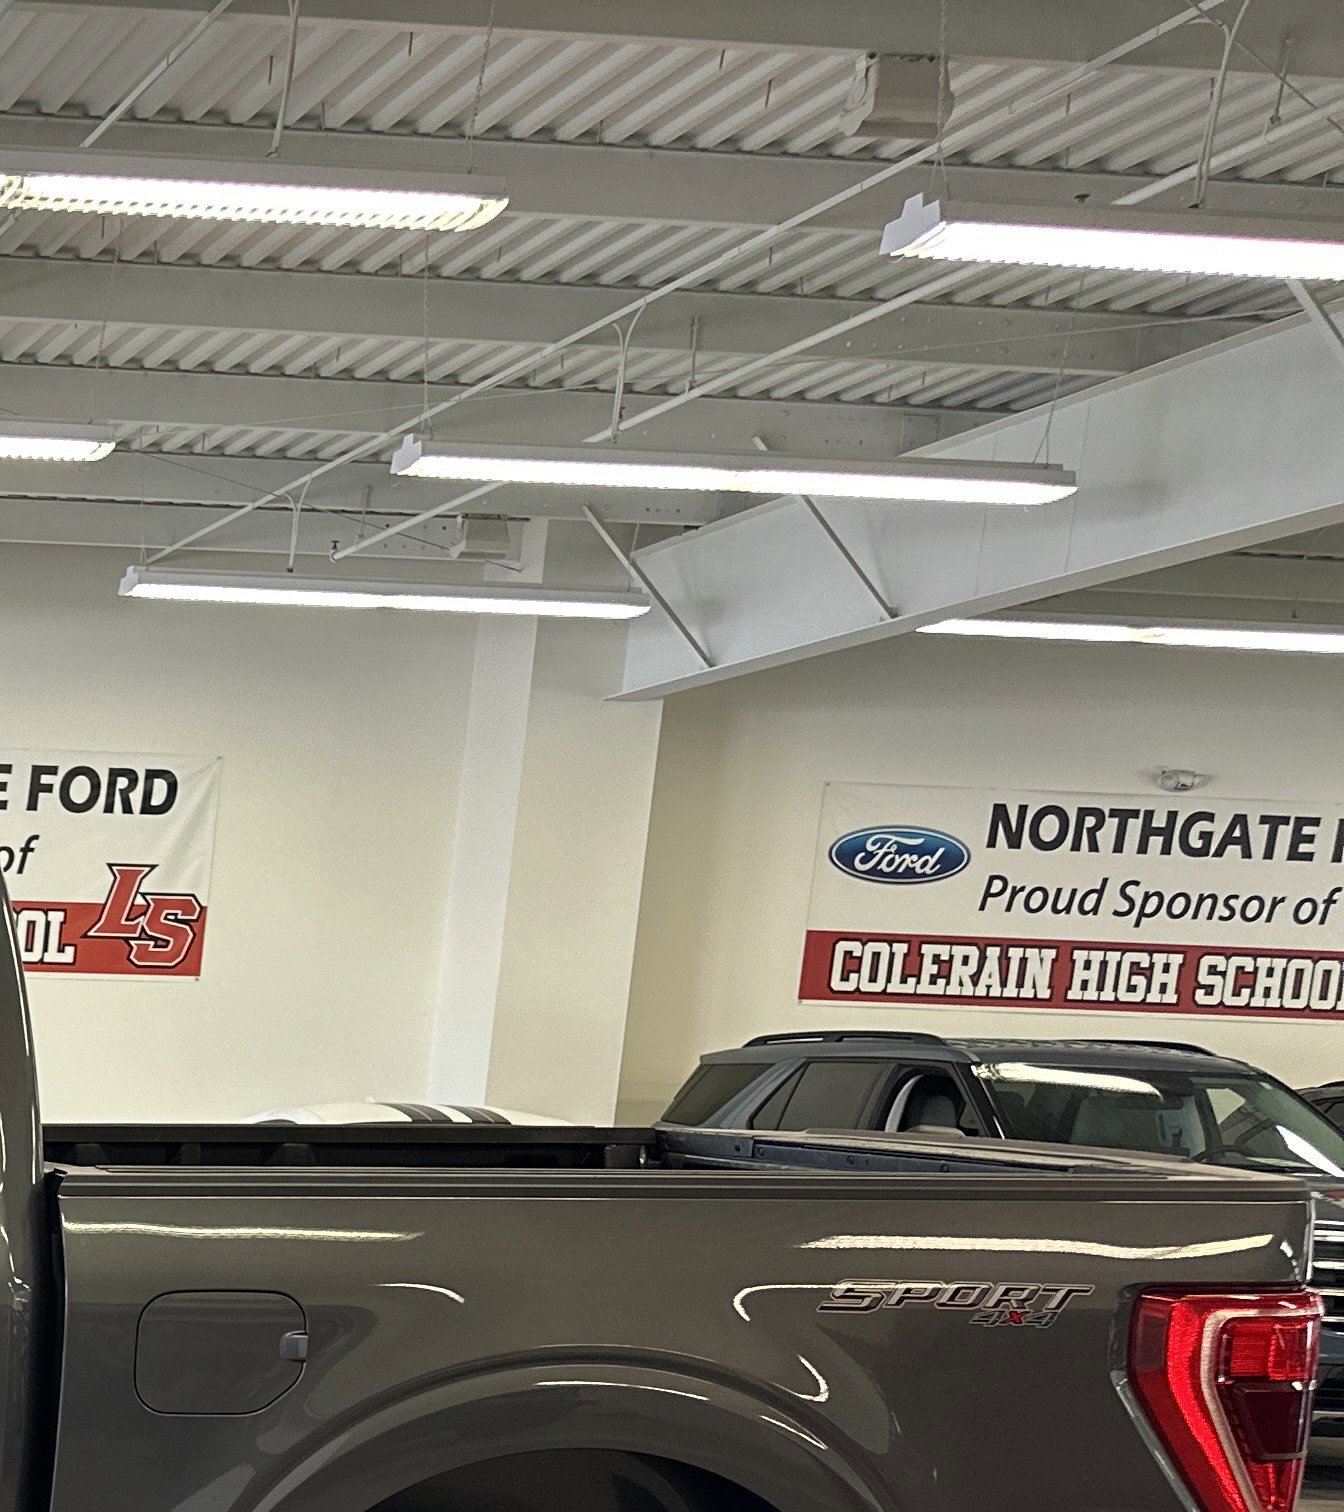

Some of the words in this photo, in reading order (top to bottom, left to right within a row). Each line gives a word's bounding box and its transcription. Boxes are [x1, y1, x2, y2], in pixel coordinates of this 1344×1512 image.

[25, 764, 178, 815] FORD
[853, 832, 942, 877] Ford
[985, 802, 1322, 863] NORTHGATE
[79, 862, 204, 969] LS
[977, 874, 1108, 917] Proud
[1112, 879, 1286, 928] Sponsor
[1292, 886, 1343, 926] of
[829, 939, 1058, 1000] COLERAIN
[1065, 948, 1184, 1005] HIGH
[1194, 955, 1344, 1011] SCHOO
[816, 1278, 1095, 1314] SPORT
